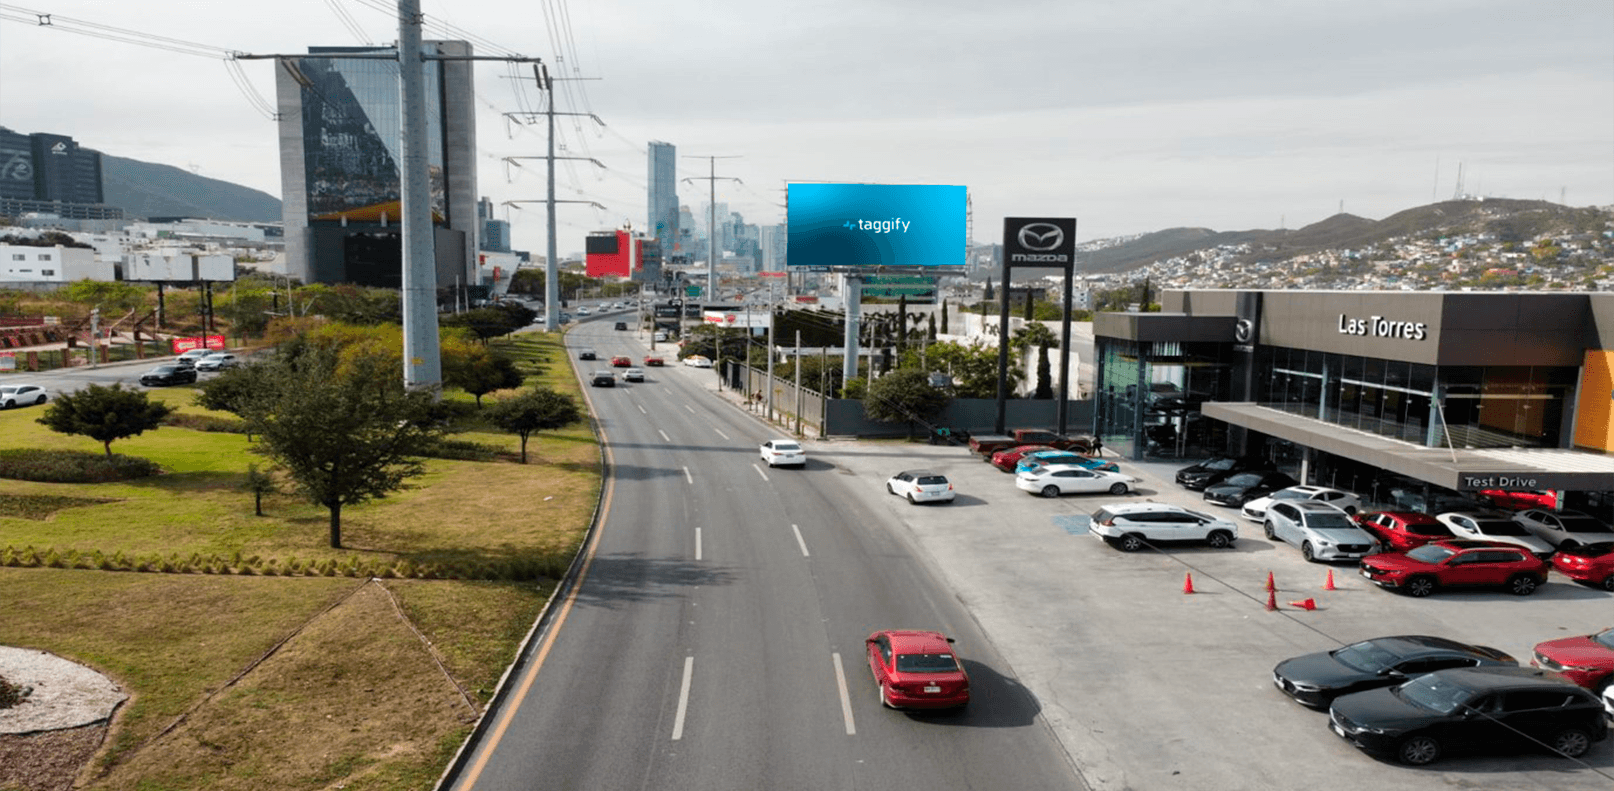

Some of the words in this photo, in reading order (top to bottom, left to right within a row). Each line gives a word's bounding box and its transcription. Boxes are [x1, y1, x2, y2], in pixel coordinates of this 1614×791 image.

[857, 217, 911, 234] taggify
[1011, 253, 1068, 262] mazda
[1338, 313, 1367, 335] Las
[1370, 315, 1426, 340] Torres
[1465, 476, 1494, 487] Test
[1499, 476, 1537, 487] Drive
